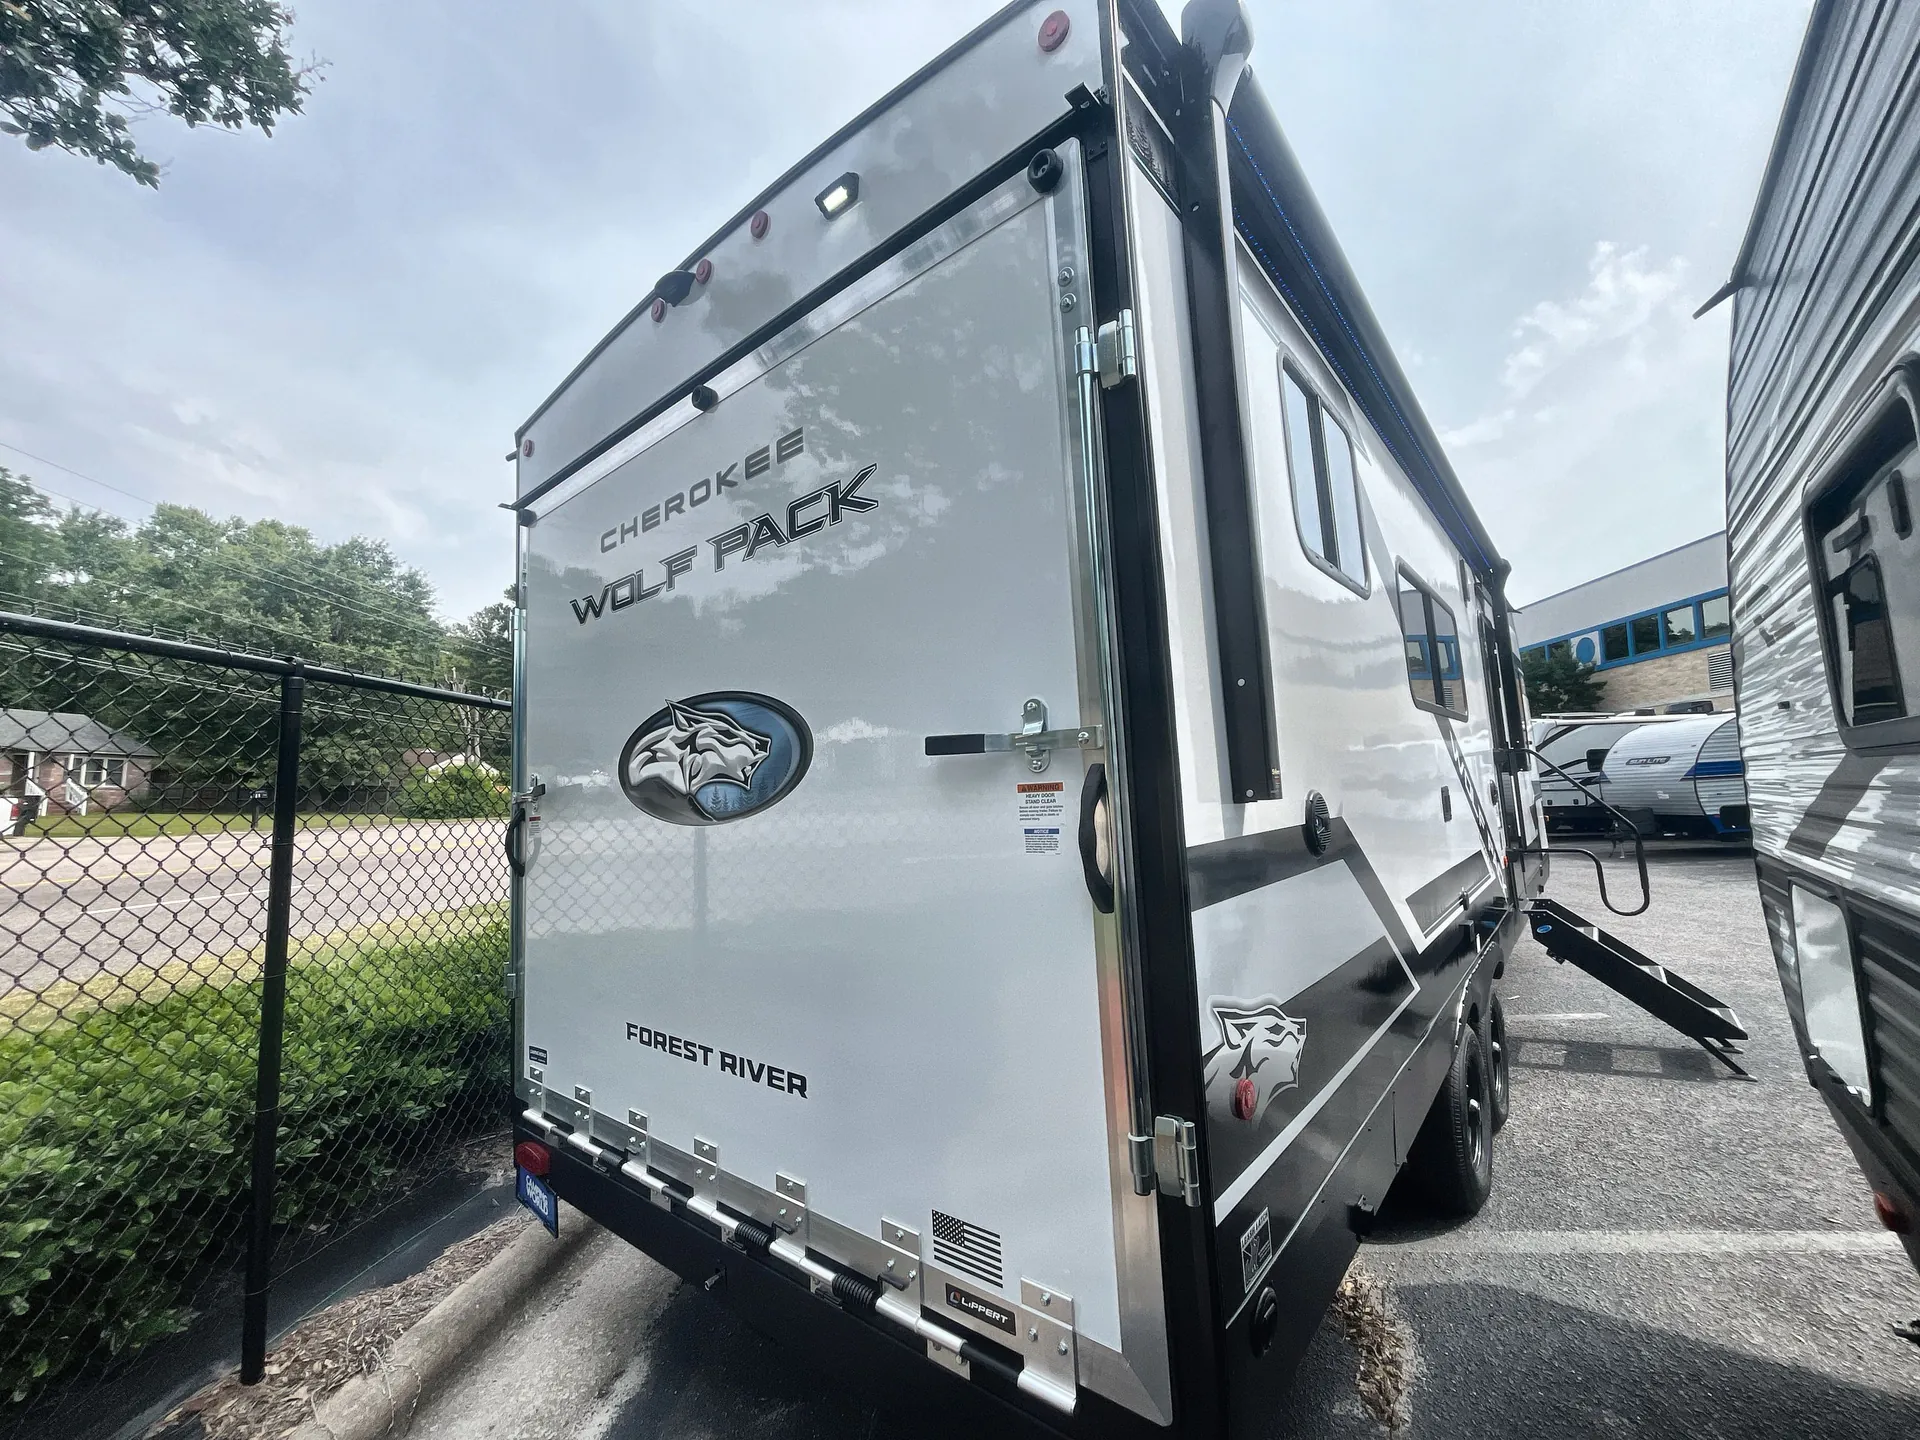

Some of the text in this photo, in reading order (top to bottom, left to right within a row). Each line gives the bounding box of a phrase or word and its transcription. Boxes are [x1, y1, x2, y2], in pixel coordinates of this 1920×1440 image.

[600, 426, 804, 554] CHEROKEE
[570, 463, 879, 626] WOLF PACK
[1028, 783, 1059, 792] WARNING
[625, 1022, 808, 1100] FOREST RIVER
[525, 1174, 548, 1202] CAMPING
[526, 1187, 549, 1216] WORLD
[961, 1296, 1008, 1324] LIPPERT
